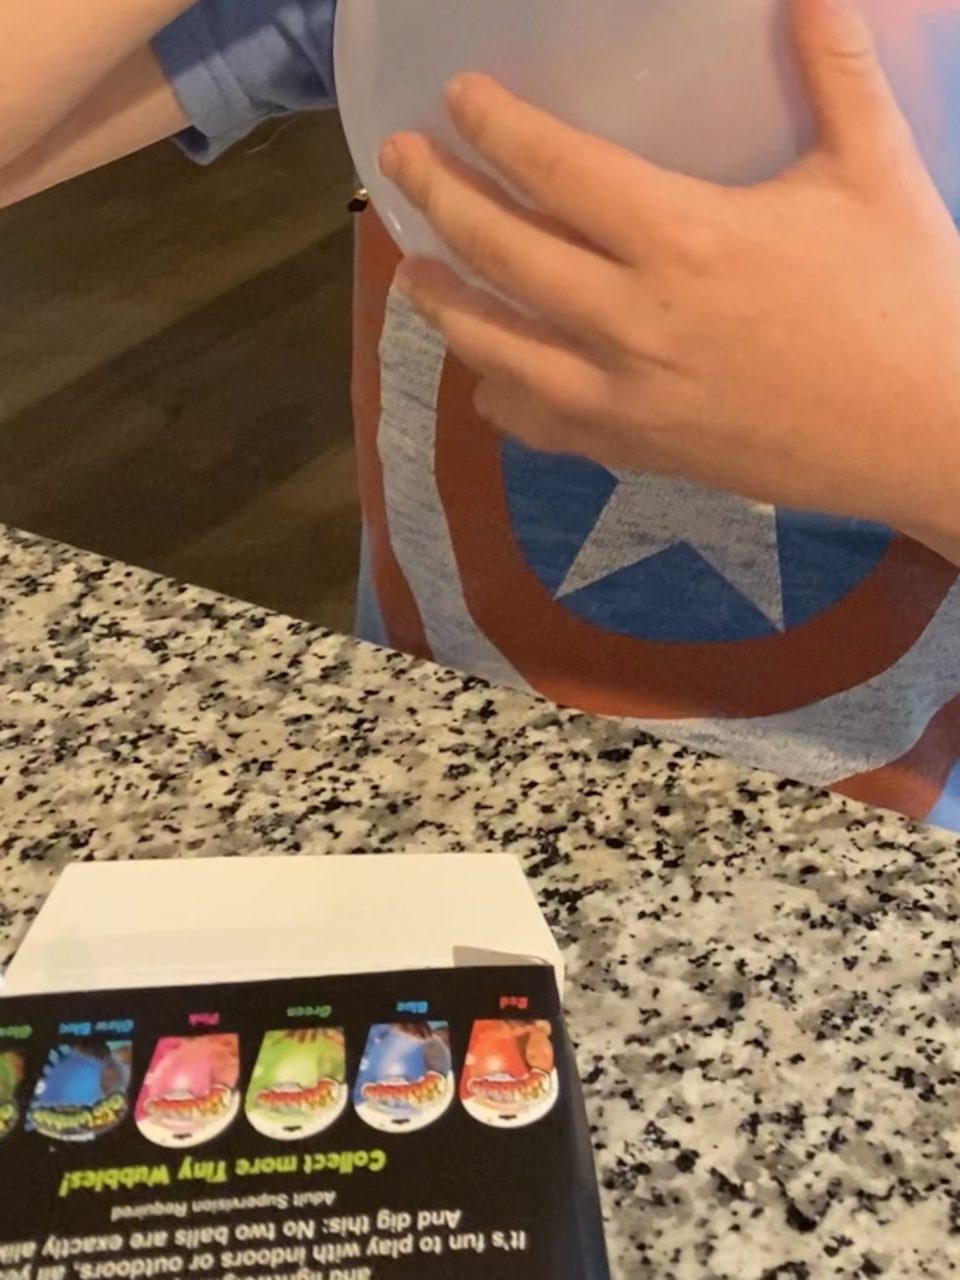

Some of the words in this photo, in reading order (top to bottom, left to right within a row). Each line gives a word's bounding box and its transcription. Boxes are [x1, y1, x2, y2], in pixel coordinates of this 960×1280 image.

[287, 1005, 332, 1018] Green
[396, 1000, 428, 1013] Blue
[500, 996, 528, 1009] Red
[178, 1156, 227, 1183] Tiny
[235, 1155, 297, 1175] more
[303, 1149, 386, 1174] Collect
[58, 1164, 170, 1197] Wubbles!
[192, 1192, 288, 1214] Supervision
[293, 1190, 336, 1207] Adult
[111, 1201, 188, 1221] Required
[376, 1209, 412, 1233] dig
[417, 1209, 462, 1230] And
[235, 1221, 276, 1241] two
[283, 1219, 315, 1239] No
[321, 1215, 370, 1236] this:
[41, 1234, 124, 1260] exactly
[129, 1231, 168, 1249] are
[174, 1225, 229, 1249] balls
[366, 1234, 414, 1258] play
[419, 1236, 442, 1255] to
[449, 1233, 485, 1253] fun
[490, 1230, 527, 1251] It's
[189, 1253, 215, 1270] or
[221, 1246, 306, 1269] indoors
[312, 1241, 361, 1263] with
[73, 1255, 184, 1280] outdoors,
